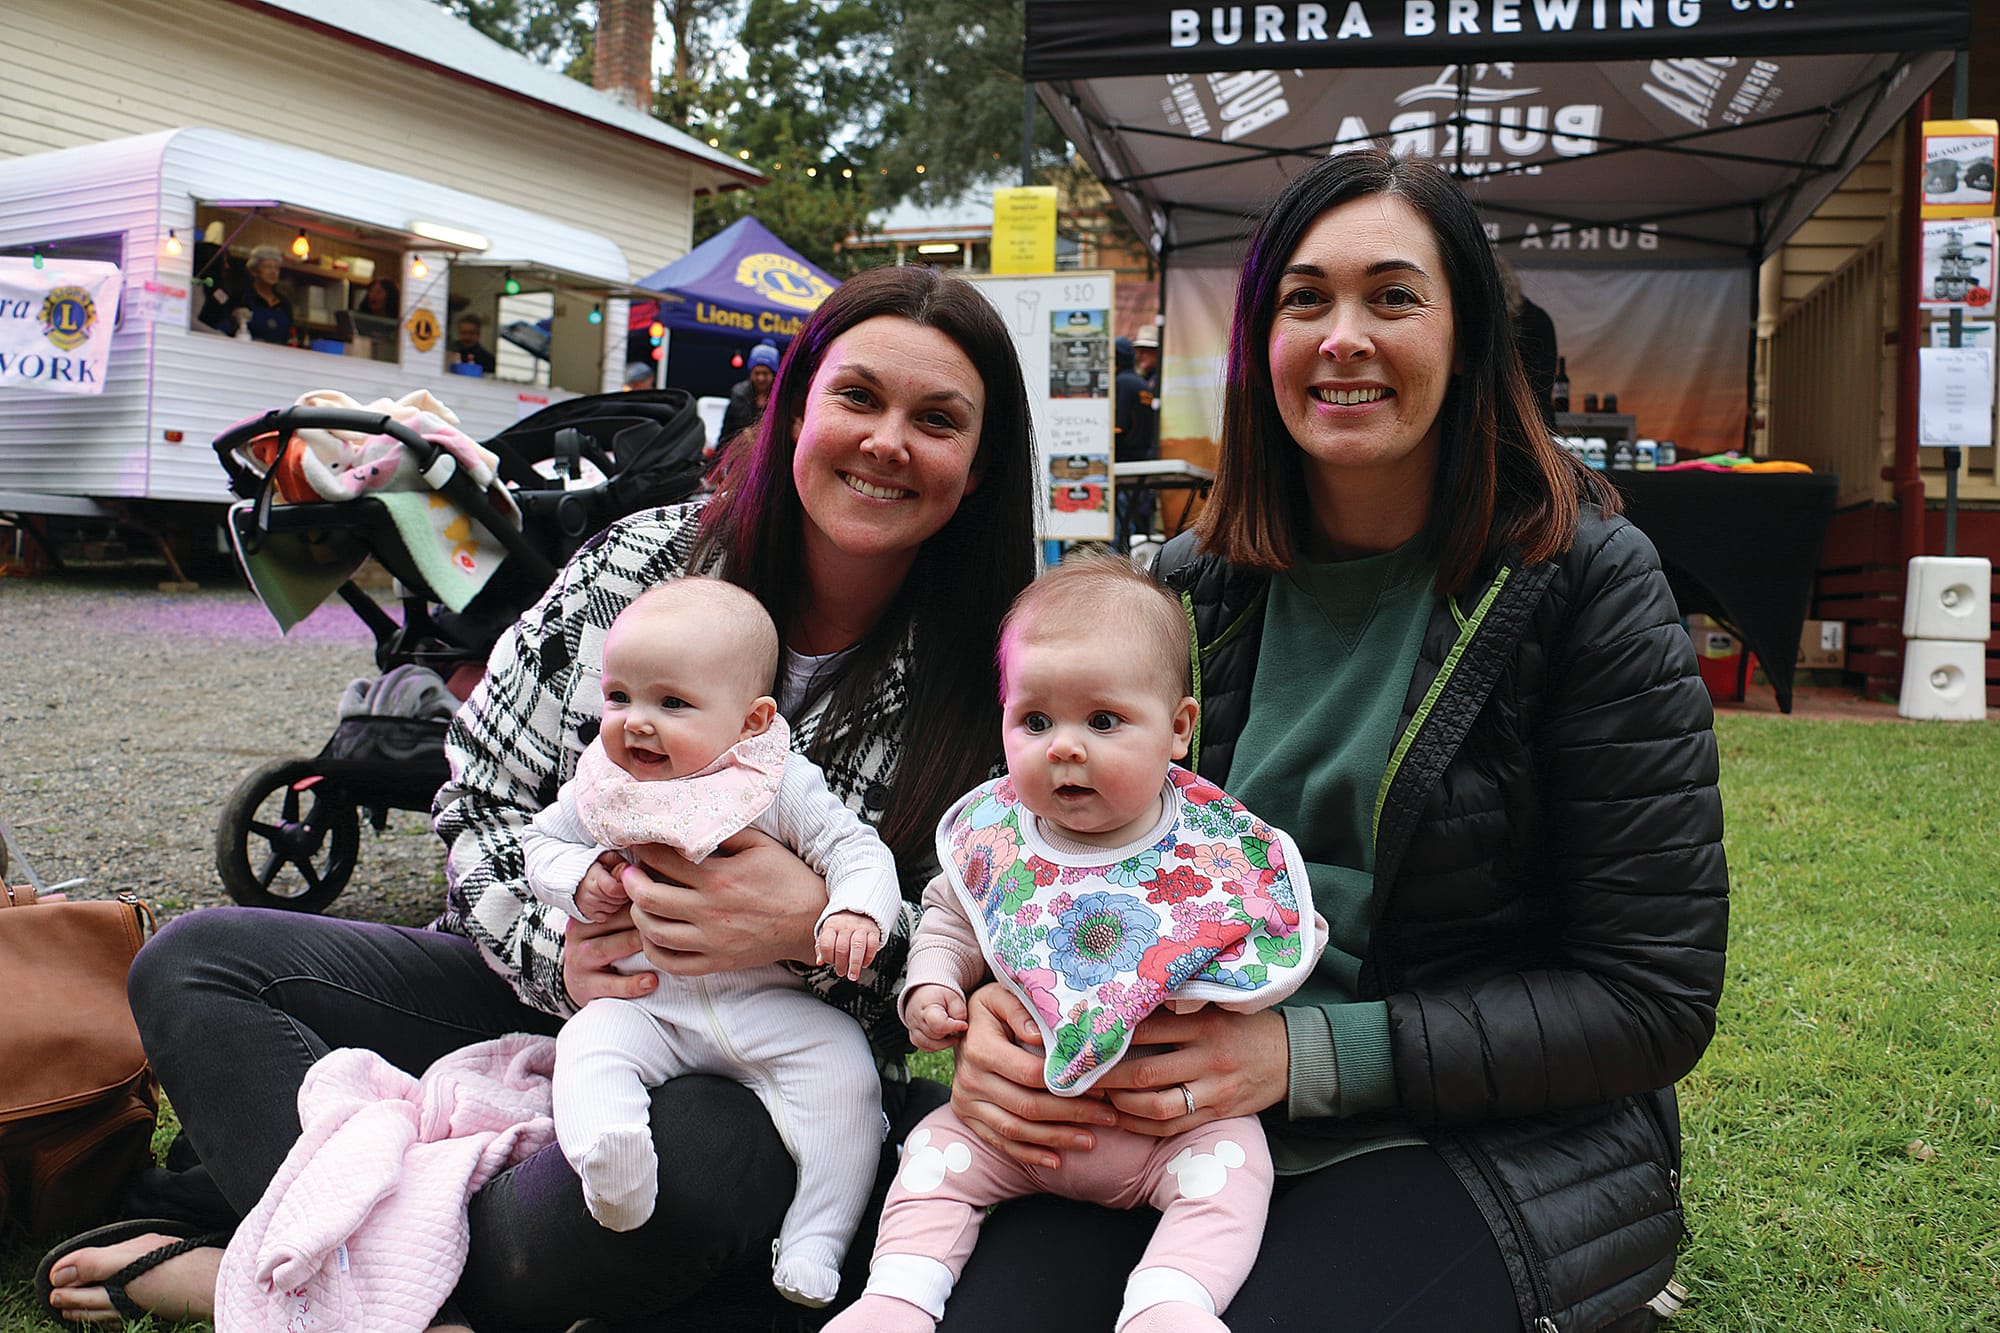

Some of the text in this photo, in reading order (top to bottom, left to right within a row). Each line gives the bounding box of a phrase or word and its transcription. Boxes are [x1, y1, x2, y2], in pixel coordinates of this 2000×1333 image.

[1170, 2, 1373, 47] BURRA
[1404, 0, 1701, 35] BREWING
[1063, 283, 1095, 302] $10
[696, 302, 754, 330] Lions
[1052, 415, 1099, 426] SPECIAL
